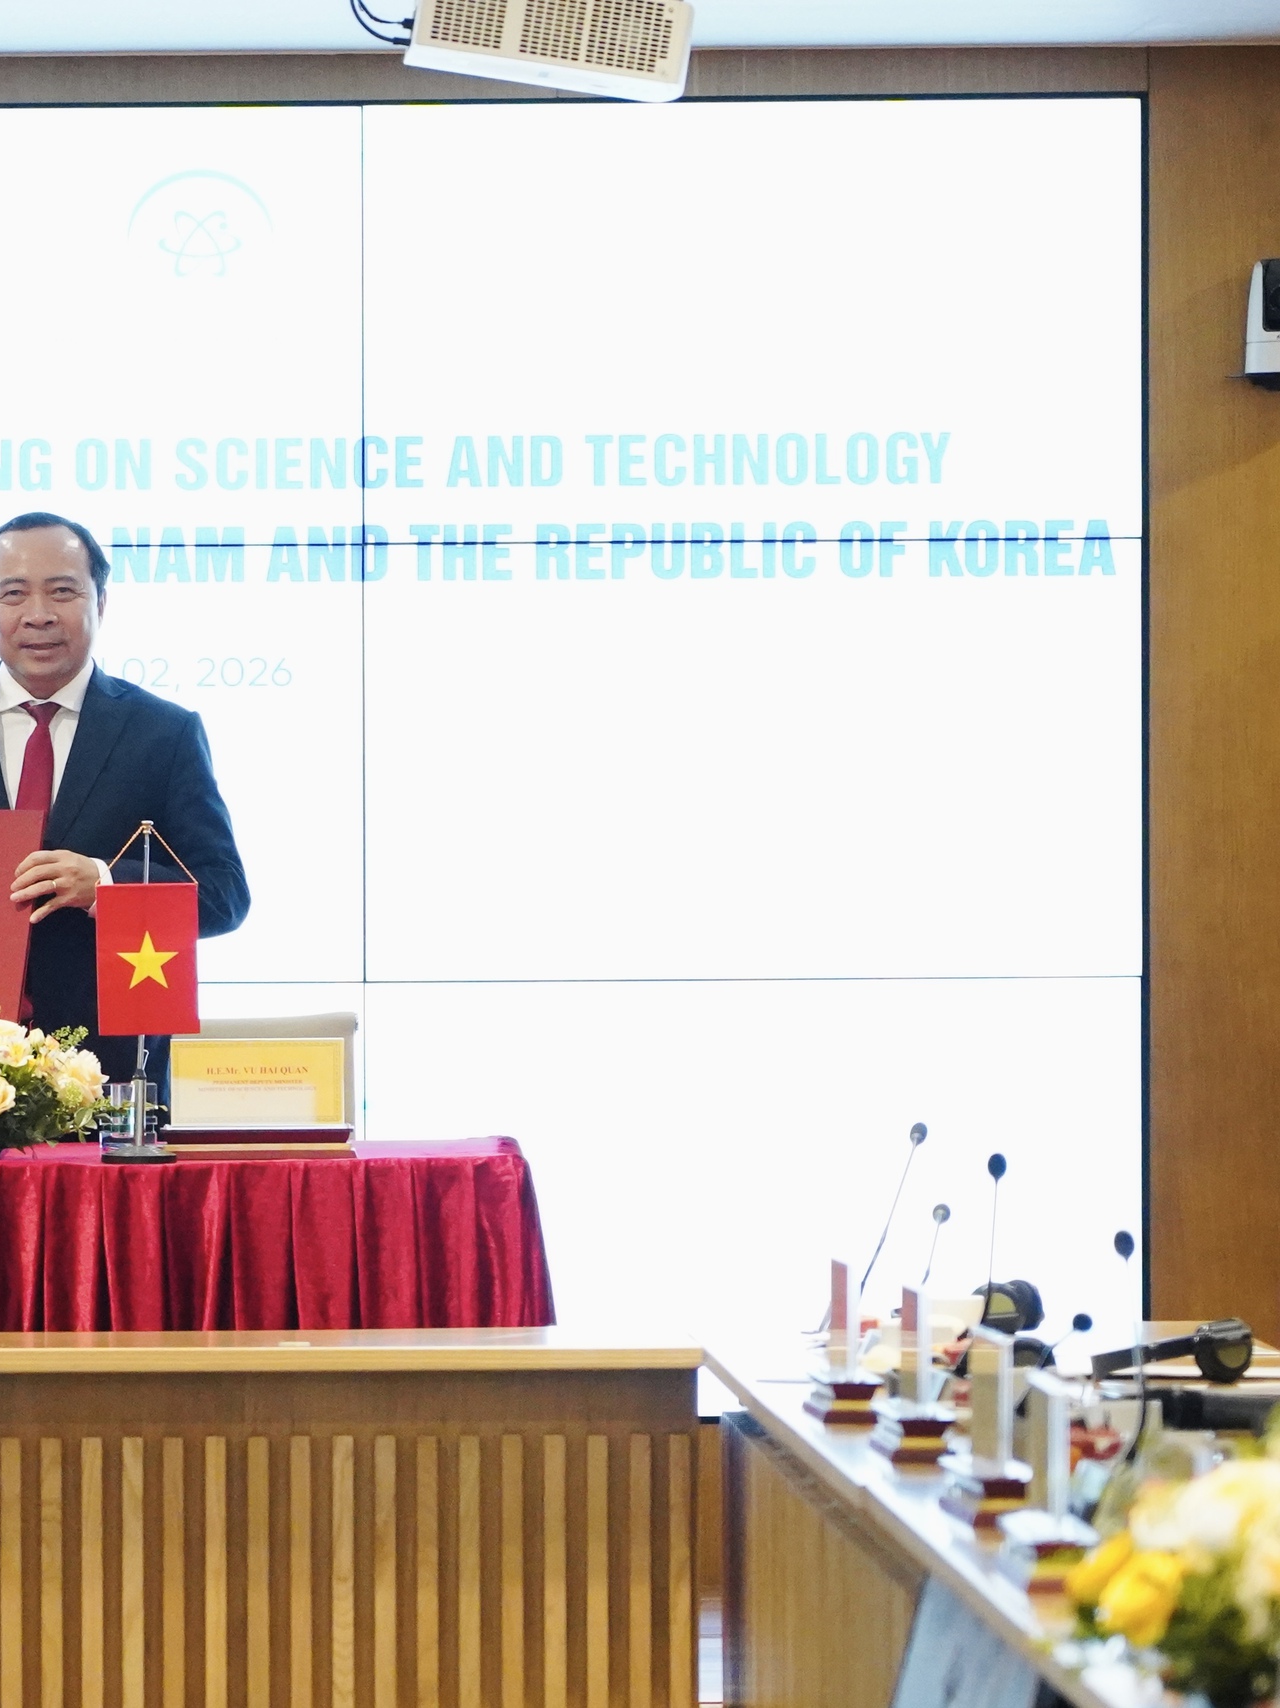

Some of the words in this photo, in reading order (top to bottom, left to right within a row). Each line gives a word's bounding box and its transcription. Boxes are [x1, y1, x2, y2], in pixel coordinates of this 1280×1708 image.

[74, 436, 153, 492] ON
[174, 435, 425, 492] SCIENCE
[445, 434, 564, 489] AND
[584, 431, 952, 488] TECHNOLOGY
[111, 525, 246, 584] NAM
[265, 523, 389, 584] AND
[408, 522, 514, 583] THE
[534, 520, 818, 582] REPUBLIC
[837, 519, 908, 580] OF
[927, 518, 1116, 579] KOREA
[121, 657, 181, 693] 02,
[196, 656, 293, 688] 2026
[243, 1066, 256, 1075] VU
[260, 1066, 278, 1075] HAI
[280, 1066, 309, 1076] QUAN
